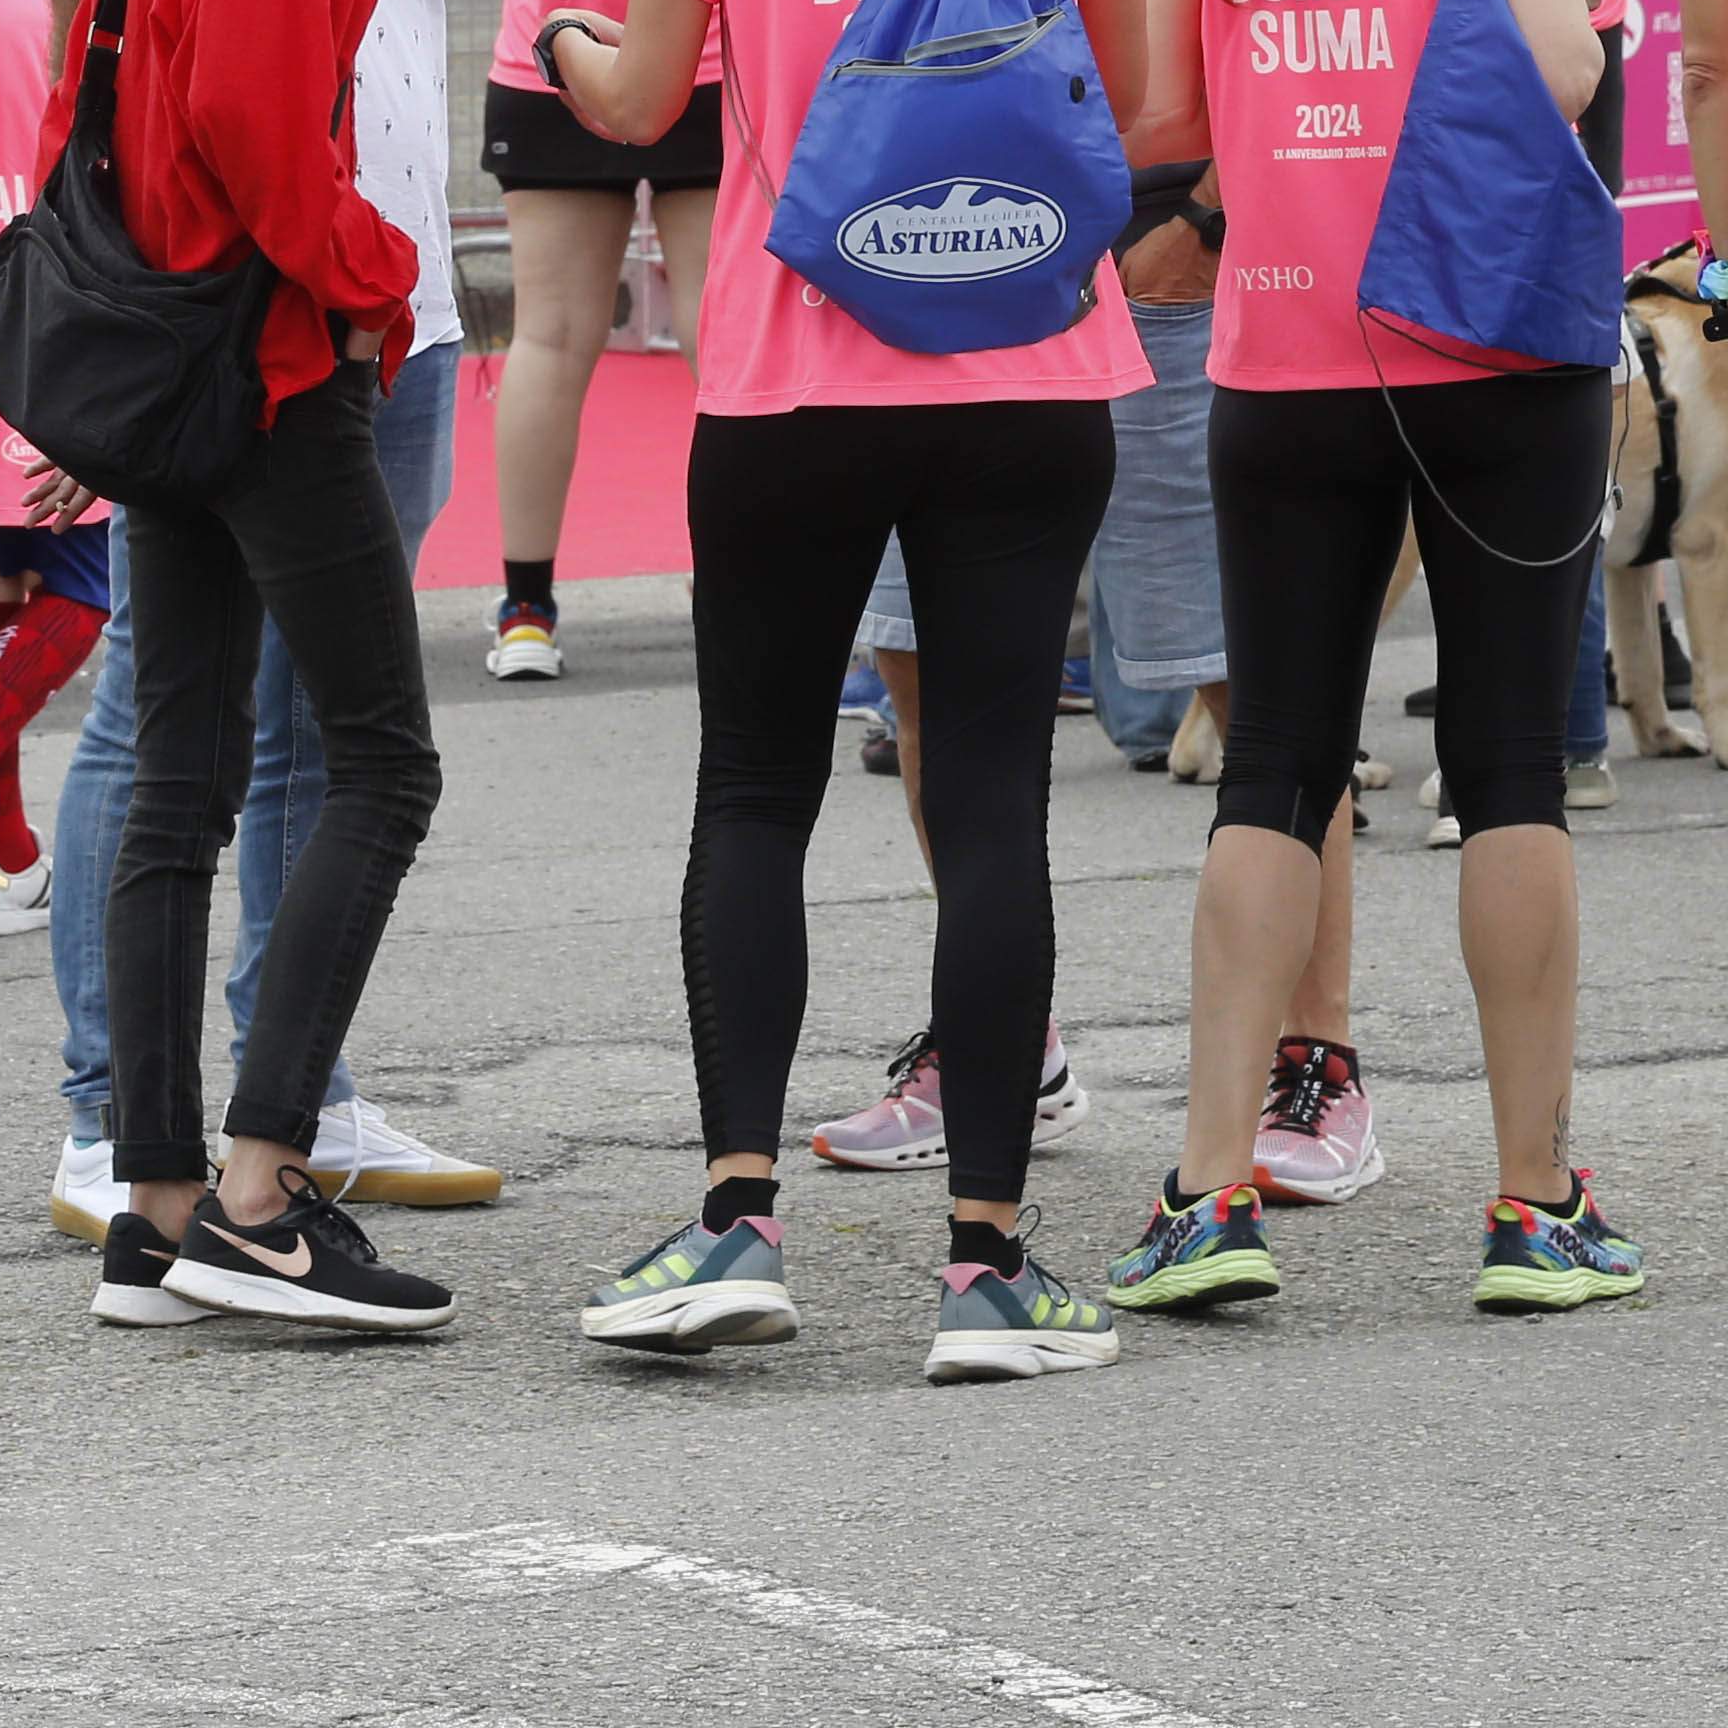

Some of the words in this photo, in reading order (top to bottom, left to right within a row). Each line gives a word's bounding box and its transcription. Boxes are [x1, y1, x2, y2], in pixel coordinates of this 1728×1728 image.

[1249, 8, 1394, 74] SUMA
[1295, 104, 1362, 139] 2024
[896, 213, 966, 227] CENTRAL
[972, 208, 1041, 224] LECHERA
[856, 218, 1046, 256] ASTURIANA
